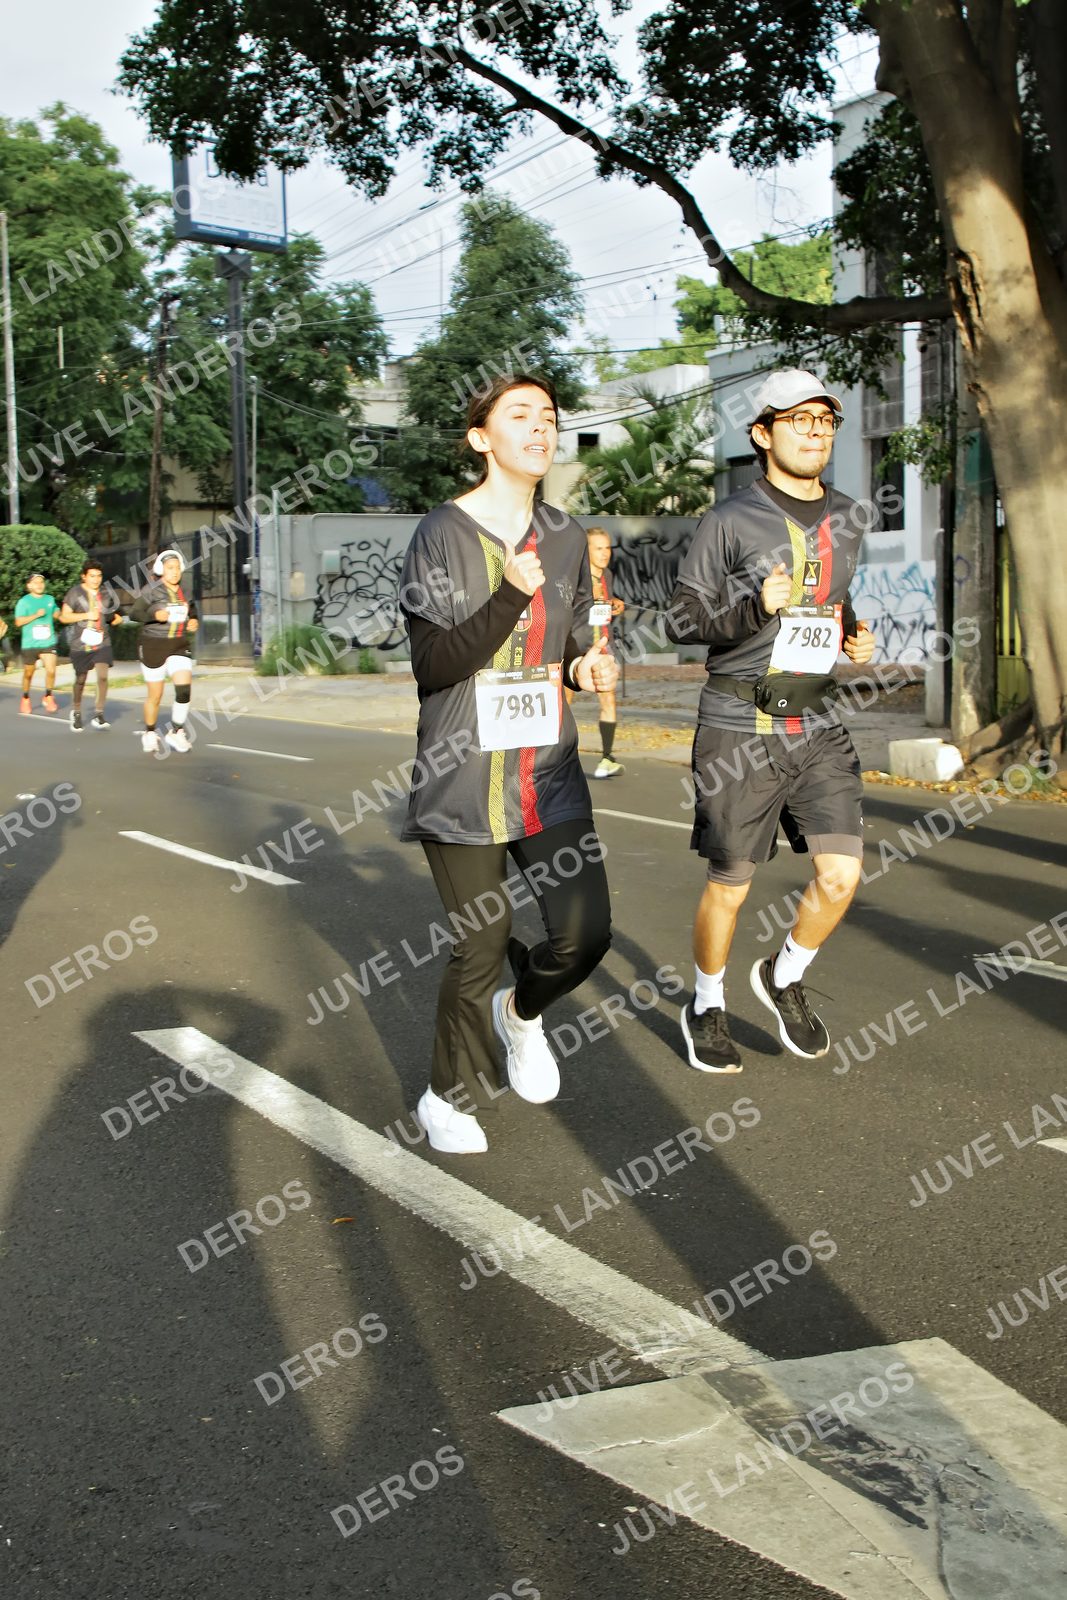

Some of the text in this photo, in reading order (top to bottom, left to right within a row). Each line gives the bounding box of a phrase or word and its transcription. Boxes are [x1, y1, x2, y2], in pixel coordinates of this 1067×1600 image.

[341, 537, 391, 556] TOY
[788, 626, 832, 648] 7982
[491, 692, 546, 720] 7981
